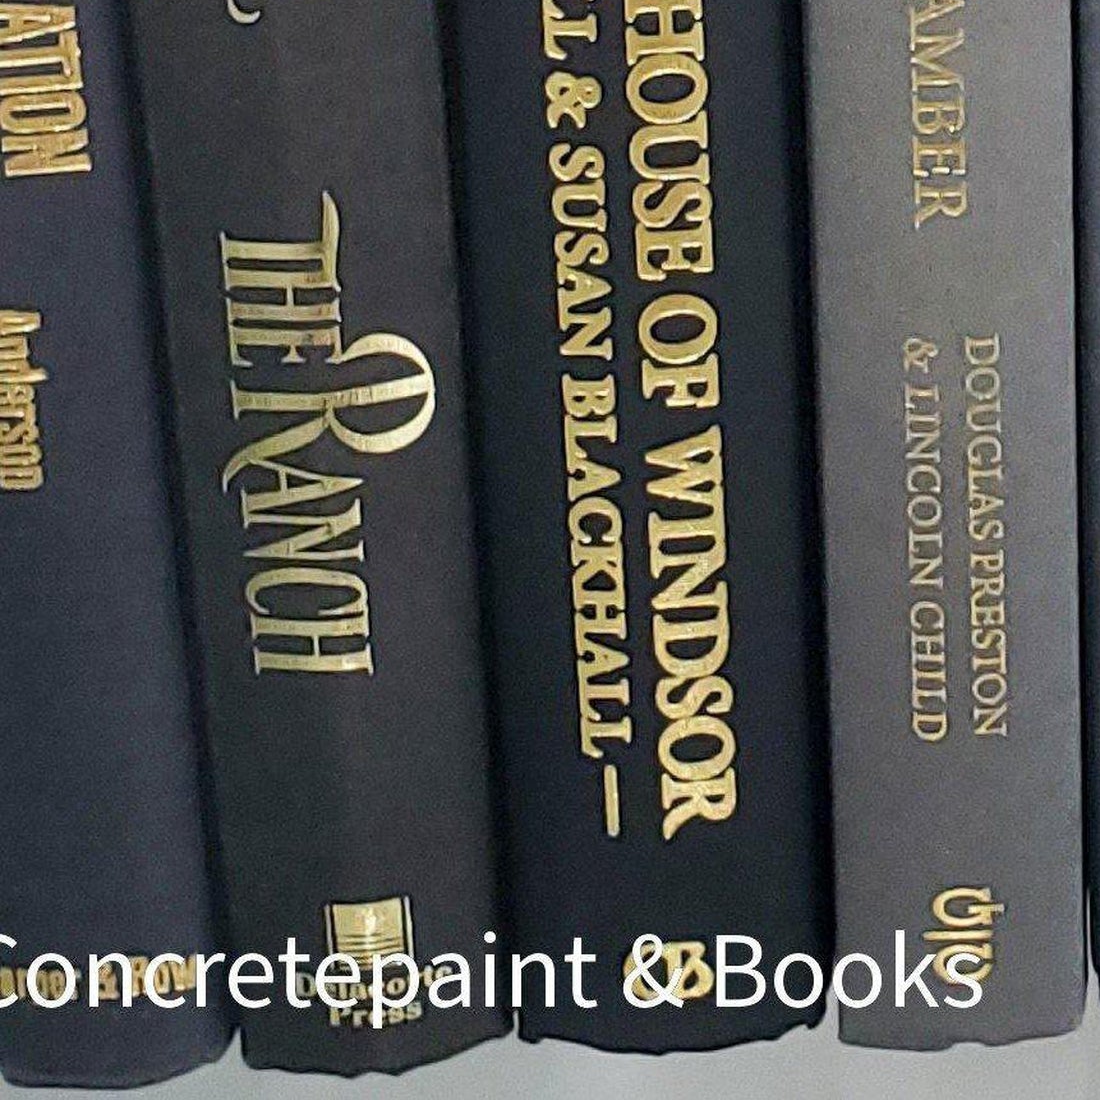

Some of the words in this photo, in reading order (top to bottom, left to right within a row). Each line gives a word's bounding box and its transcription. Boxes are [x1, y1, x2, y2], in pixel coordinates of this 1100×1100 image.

[545, 72, 601, 128] &
[221, 192, 345, 367] THE
[549, 144, 612, 360] SUSAN
[639, 295, 719, 408] OF
[904, 337, 940, 373] &
[965, 335, 1004, 542] DOUGLAS
[223, 331, 435, 675] RANCH
[562, 374, 631, 758] BLACKHALL
[905, 384, 943, 589] LINCOLN
[645, 425, 736, 840] WINDSOR
[910, 600, 950, 743] CHILD
[970, 551, 1008, 738] PRESTON
[296, 964, 453, 1001] Dlaote
